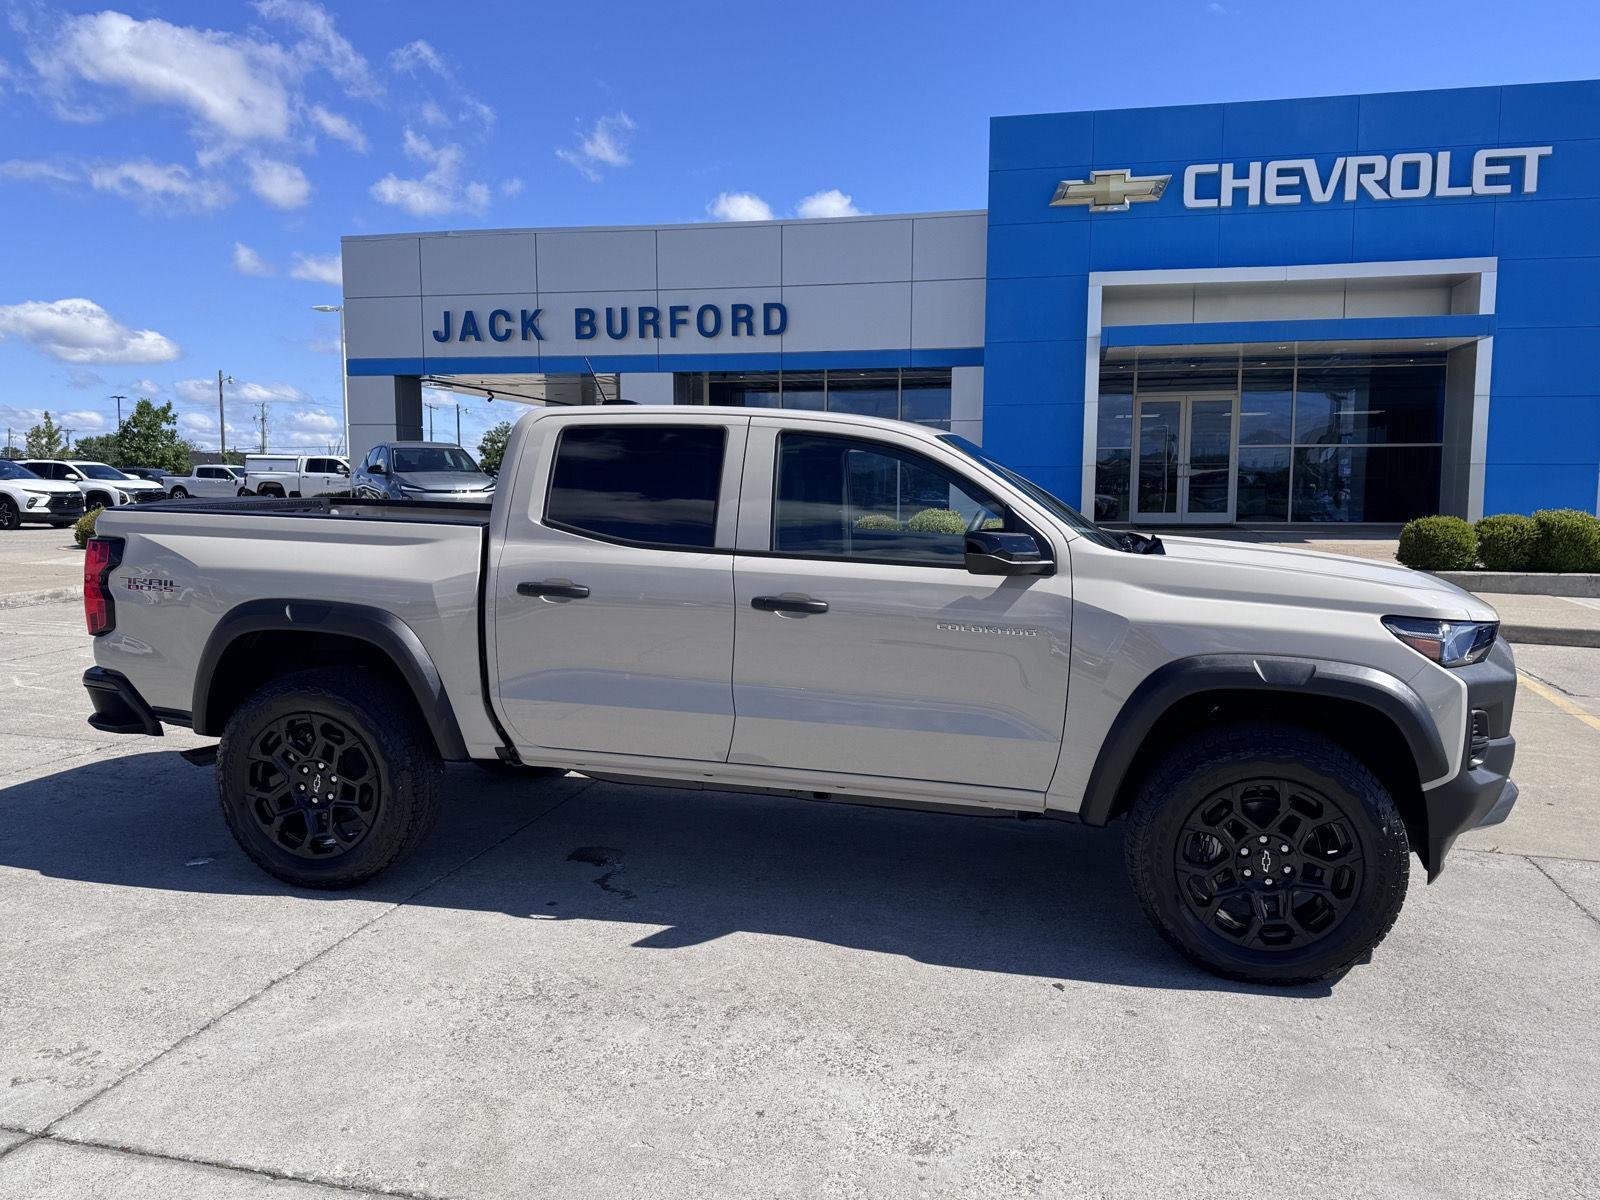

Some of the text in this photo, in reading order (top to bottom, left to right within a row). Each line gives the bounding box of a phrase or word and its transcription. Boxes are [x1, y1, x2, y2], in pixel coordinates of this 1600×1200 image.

[1183, 145, 1553, 209] CHEVROLET
[432, 302, 789, 343] JACK BURFORD
[120, 577, 181, 588] TRAIL
